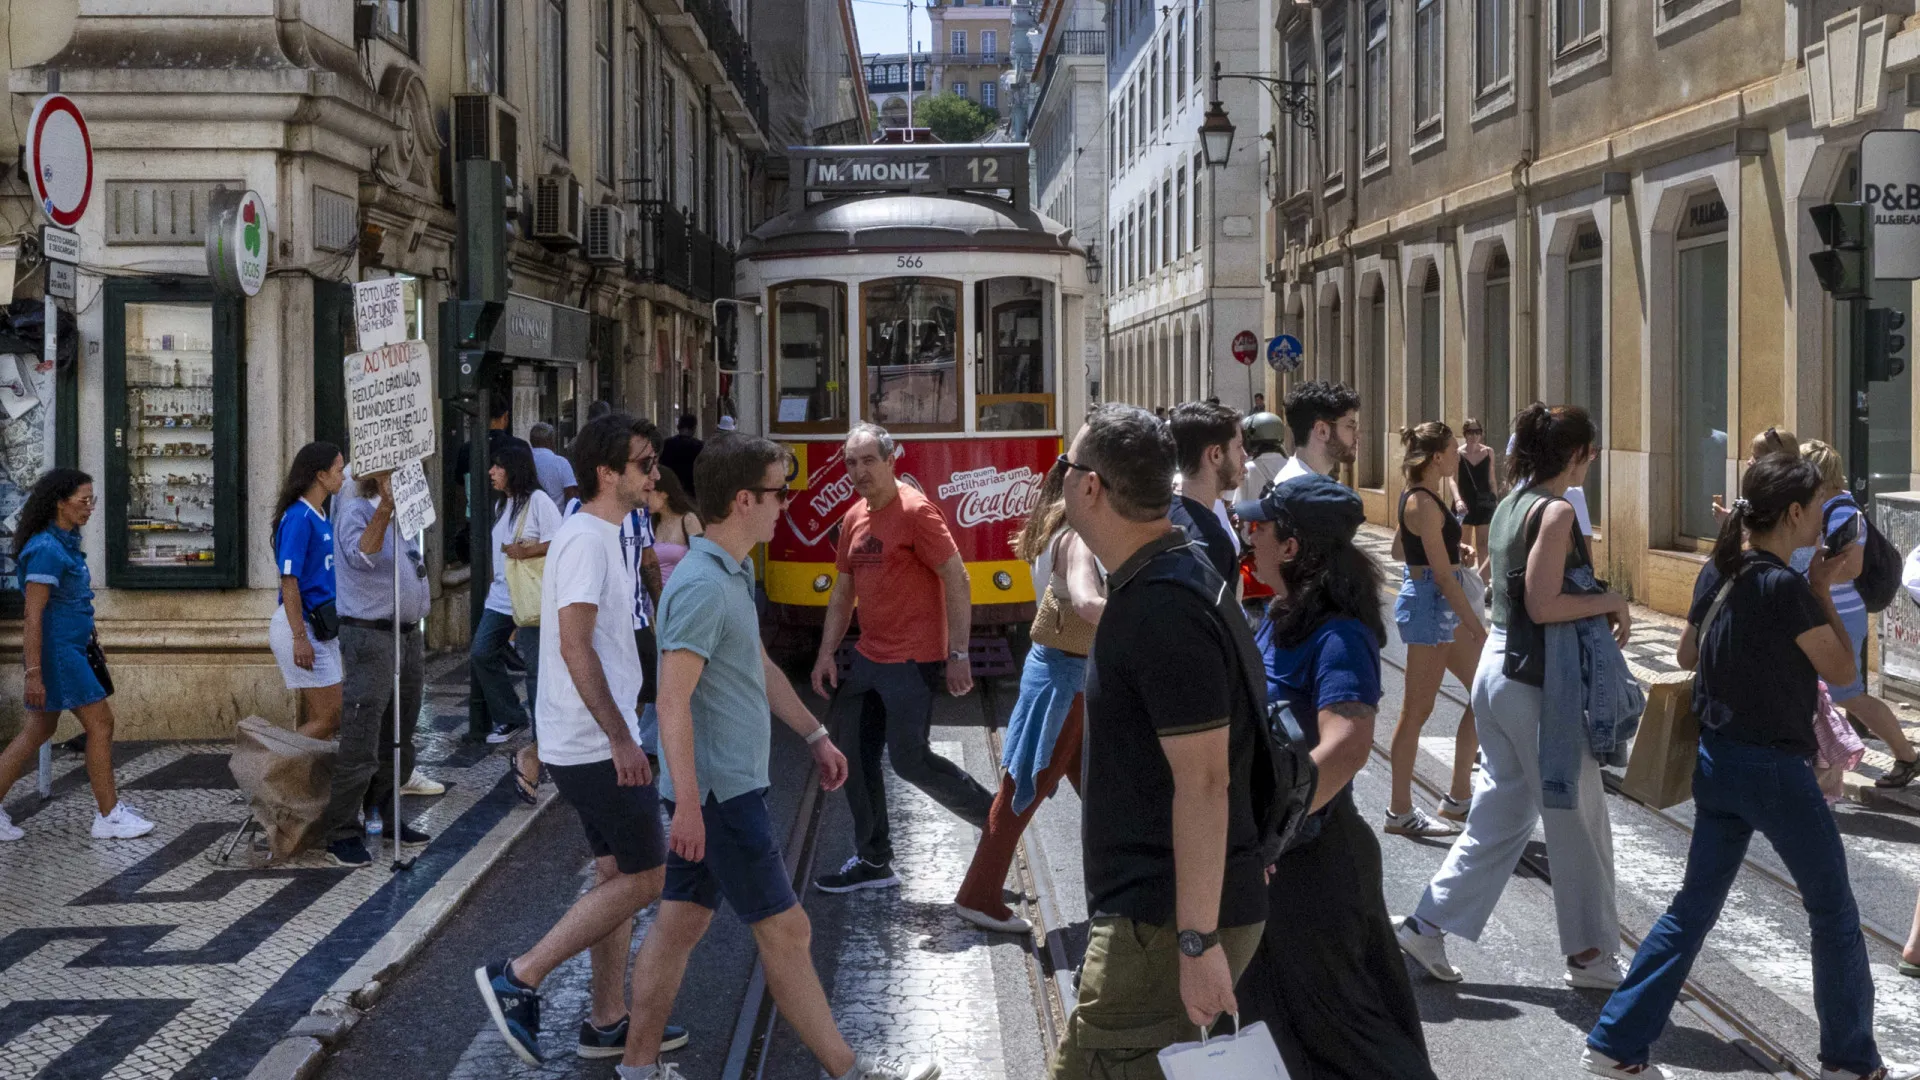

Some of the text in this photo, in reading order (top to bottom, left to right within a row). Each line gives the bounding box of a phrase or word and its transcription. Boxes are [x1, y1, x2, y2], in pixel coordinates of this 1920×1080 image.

[818, 162, 931, 182] M. MONIZ
[967, 157, 999, 183] 12
[896, 256, 923, 269] 566
[359, 286, 380, 303] FOTO
[360, 305, 368, 320] A
[363, 351, 379, 376] AO
[382, 343, 411, 370] MUNDO
[354, 441, 373, 460] CAOS
[940, 469, 1030, 497] partilharias uma
[952, 468, 995, 481] Com quem
